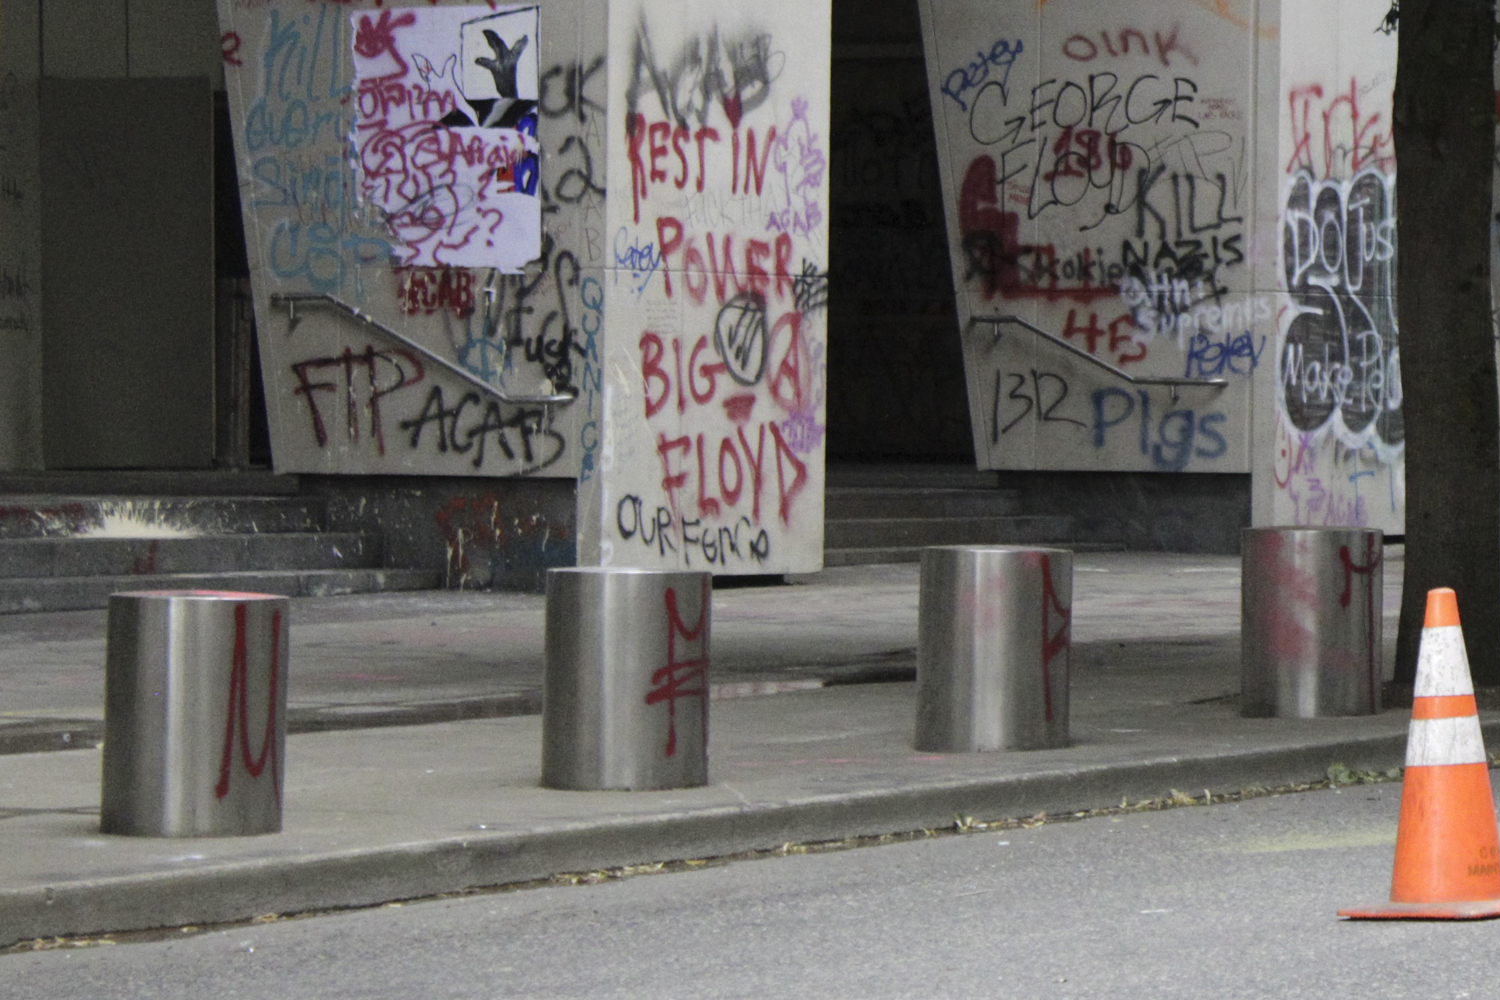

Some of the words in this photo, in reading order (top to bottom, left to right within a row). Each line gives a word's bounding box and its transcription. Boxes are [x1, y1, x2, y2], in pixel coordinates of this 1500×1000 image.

[970, 72, 1200, 146] GEORGE
[625, 110, 722, 225] REST
[1134, 161, 1245, 239] KILL
[656, 215, 796, 308] POWER
[291, 344, 425, 458] FTP
[639, 329, 729, 419] BIG
[400, 385, 567, 478] ACAB
[658, 421, 807, 526] FLOYD
[616, 493, 677, 558] OUR
